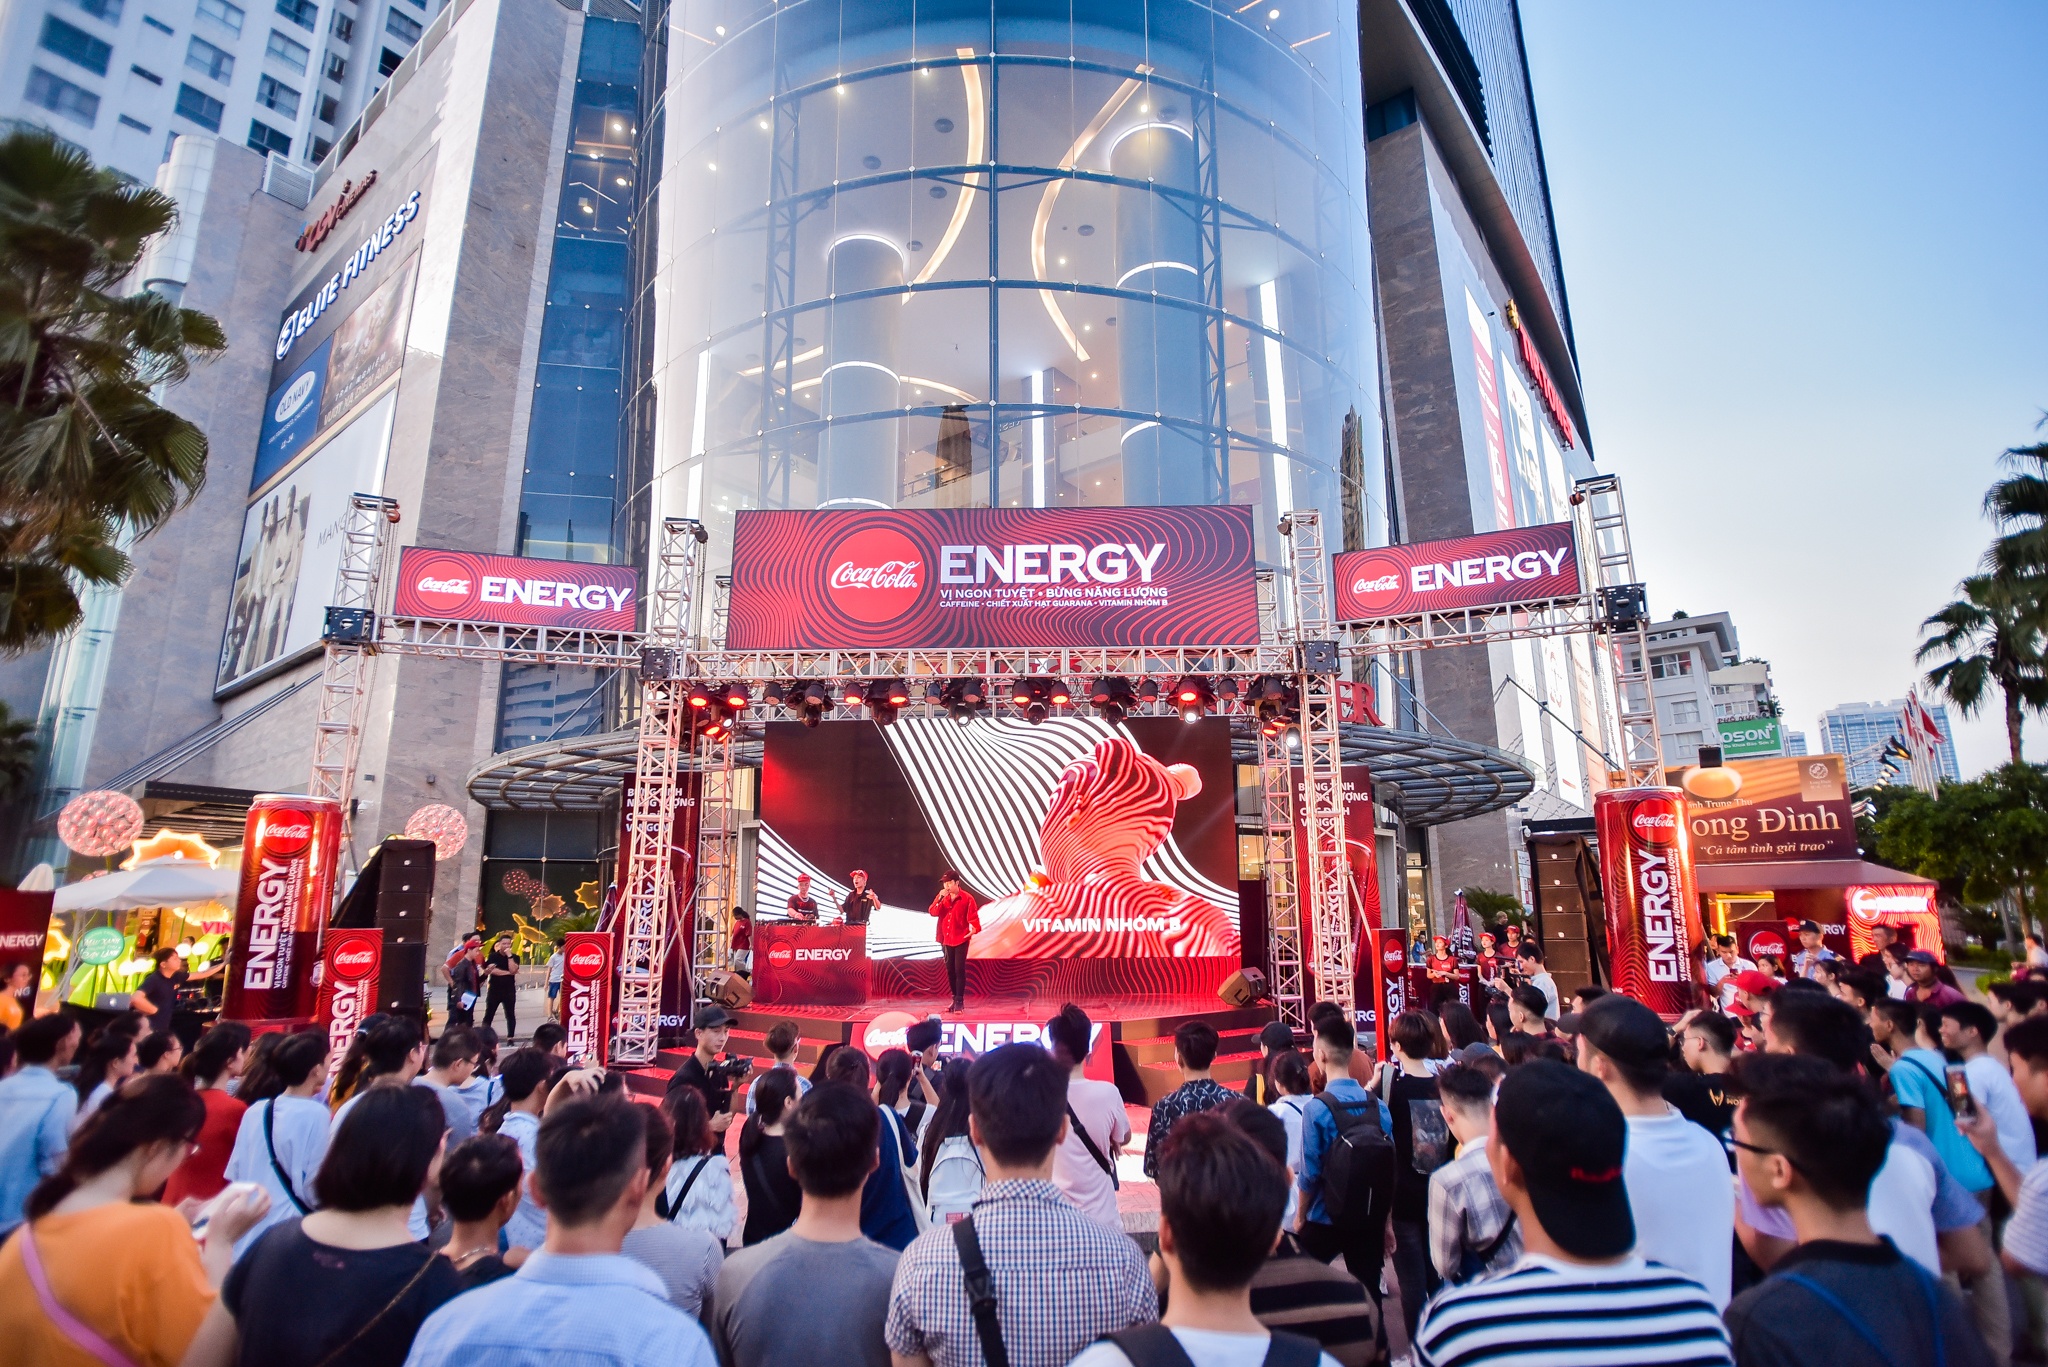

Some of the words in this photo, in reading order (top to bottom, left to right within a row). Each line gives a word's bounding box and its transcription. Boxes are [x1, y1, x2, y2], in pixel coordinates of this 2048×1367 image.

[306, 193, 345, 252] CGV
[295, 272, 342, 337] ELITE
[341, 191, 420, 289] FITNESS
[280, 396, 292, 416] OLD
[292, 378, 312, 406] NAVY
[316, 511, 346, 550] MANG
[940, 542, 1166, 584] ENERGY
[1410, 546, 1567, 593] ENERGY
[830, 560, 920, 589] Coca-Cola
[417, 577, 471, 594] Coca-Cola
[1046, 586, 1082, 597] BỪNG
[1085, 586, 1120, 597] NĂNG
[1124, 586, 1168, 599] LƯỢNG
[1353, 574, 1399, 594] Coca-Cola
[480, 576, 632, 612] ENERGY
[940, 589, 952, 600] VỊ
[955, 589, 992, 598] NGON
[995, 586, 1035, 600] TUYỆT
[986, 599, 1010, 607] CHIẾT
[1012, 598, 1033, 607] XUẤT
[1134, 598, 1160, 606] NHÓM
[1721, 729, 1770, 743] OSON
[1688, 800, 1703, 809] ánh
[1634, 814, 1675, 827] Coca-Cola
[1692, 816, 1750, 842] ong
[1757, 805, 1842, 833] Đình
[265, 823, 311, 838] Coca-Cola
[1726, 844, 1747, 855] tâm
[1751, 842, 1773, 853] tình
[1776, 841, 1796, 855] gửi
[1022, 918, 1100, 932] VITAMIN
[1106, 914, 1165, 932] NHÓM
[1169, 917, 1181, 931] B
[1638, 849, 1678, 982] ENERGY
[202, 922, 232, 934] VIN
[244, 859, 290, 990] ENERGY
[1821, 924, 1846, 935] RGY
[0, 934, 44, 947] NERGY
[1752, 943, 1785, 954] Coca-Cola
[336, 951, 373, 964] Coca-Cola
[570, 954, 602, 965] Coca-Cola
[768, 950, 792, 960] Coca-Cola
[795, 948, 851, 961] ENERGY
[1384, 950, 1403, 962] Coca-Cola
[1677, 949, 1686, 972] NGON
[275, 958, 284, 980] NGON
[1386, 977, 1400, 1026] RGY
[1459, 983, 1468, 1005] RGY
[567, 980, 590, 1064] NERGY
[1350, 1010, 1376, 1022] ERG
[328, 981, 357, 1075] NERGY
